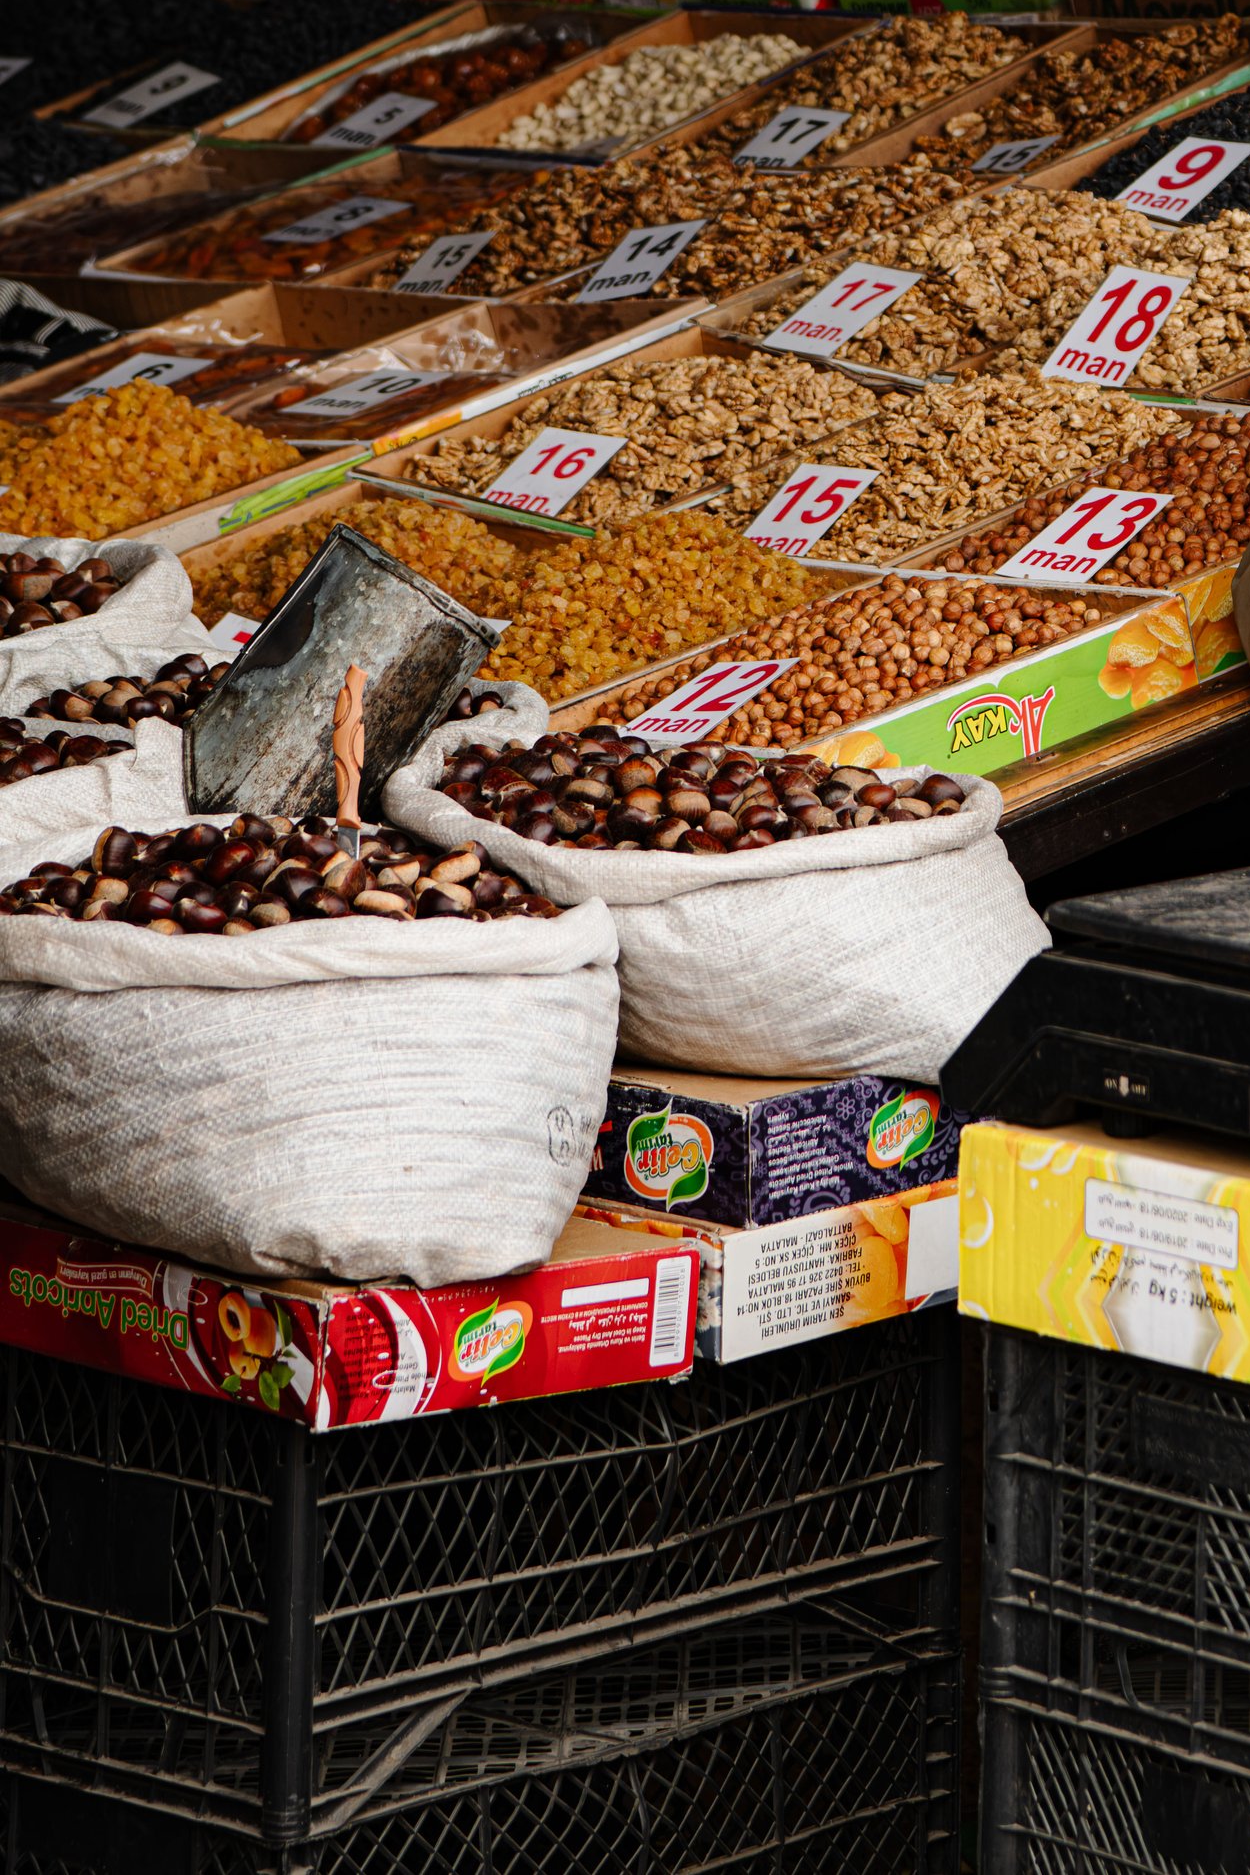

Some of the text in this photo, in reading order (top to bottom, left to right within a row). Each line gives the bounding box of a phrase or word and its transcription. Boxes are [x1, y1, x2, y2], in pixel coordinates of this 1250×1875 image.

[374, 107, 405, 125] 5
[770, 116, 831, 145] 17
[988, 144, 1040, 170] 15
[1158, 145, 1226, 190] 9
[1126, 186, 1190, 213] man
[432, 243, 473, 269] 15
[625, 229, 686, 262] 14
[587, 270, 654, 293] man.
[833, 278, 898, 312] 17
[1086, 277, 1174, 353] 18
[783, 316, 844, 343] man.
[1057, 344, 1128, 381] man
[356, 375, 424, 394] 10
[530, 444, 597, 480] 16
[773, 475, 862, 525] 15
[1054, 493, 1159, 551] 13
[1019, 546, 1098, 575] man
[670, 662, 781, 714] 12
[877, 1107, 929, 1150] Gelir
[637, 1139, 700, 1177] Gelir
[761, 1222, 852, 1253] BATTALGAZİ MALATYA
[817, 1241, 832, 1255] MH.
[834, 1233, 857, 1250] ÇİÇEK
[755, 1258, 760, 1269] 5
[792, 1245, 814, 1260] ÇİÇEK
[747, 1247, 862, 1287] FABRİKA: HANTUSYU BELDESİ
[748, 1261, 861, 1299] TEL: 0422 326 17 95 MALATYA
[845, 1272, 870, 1288] BÜYÜK
[795, 1285, 822, 1301] PAZARI
[825, 1279, 842, 1293] ŞİRE
[1148, 1279, 1237, 1314] weight 5 kg
[9, 1268, 189, 1351] Dried Apricots
[757, 1291, 850, 1326] SANAYİ VE TİC. LTD. ŞTİ.
[602, 1331, 612, 1339] And
[613, 1329, 625, 1337] Cool
[632, 1325, 646, 1334] Keep
[761, 1305, 844, 1340] ŞEN TARIM ÜRÜNLERİ
[460, 1320, 521, 1362] Gelir
[573, 1334, 591, 1342] Places
[587, 1339, 609, 1350] Ortamda
[592, 1332, 601, 1341] Dry
[610, 1338, 623, 1346] Kuru
[631, 1334, 645, 1343] Serin
